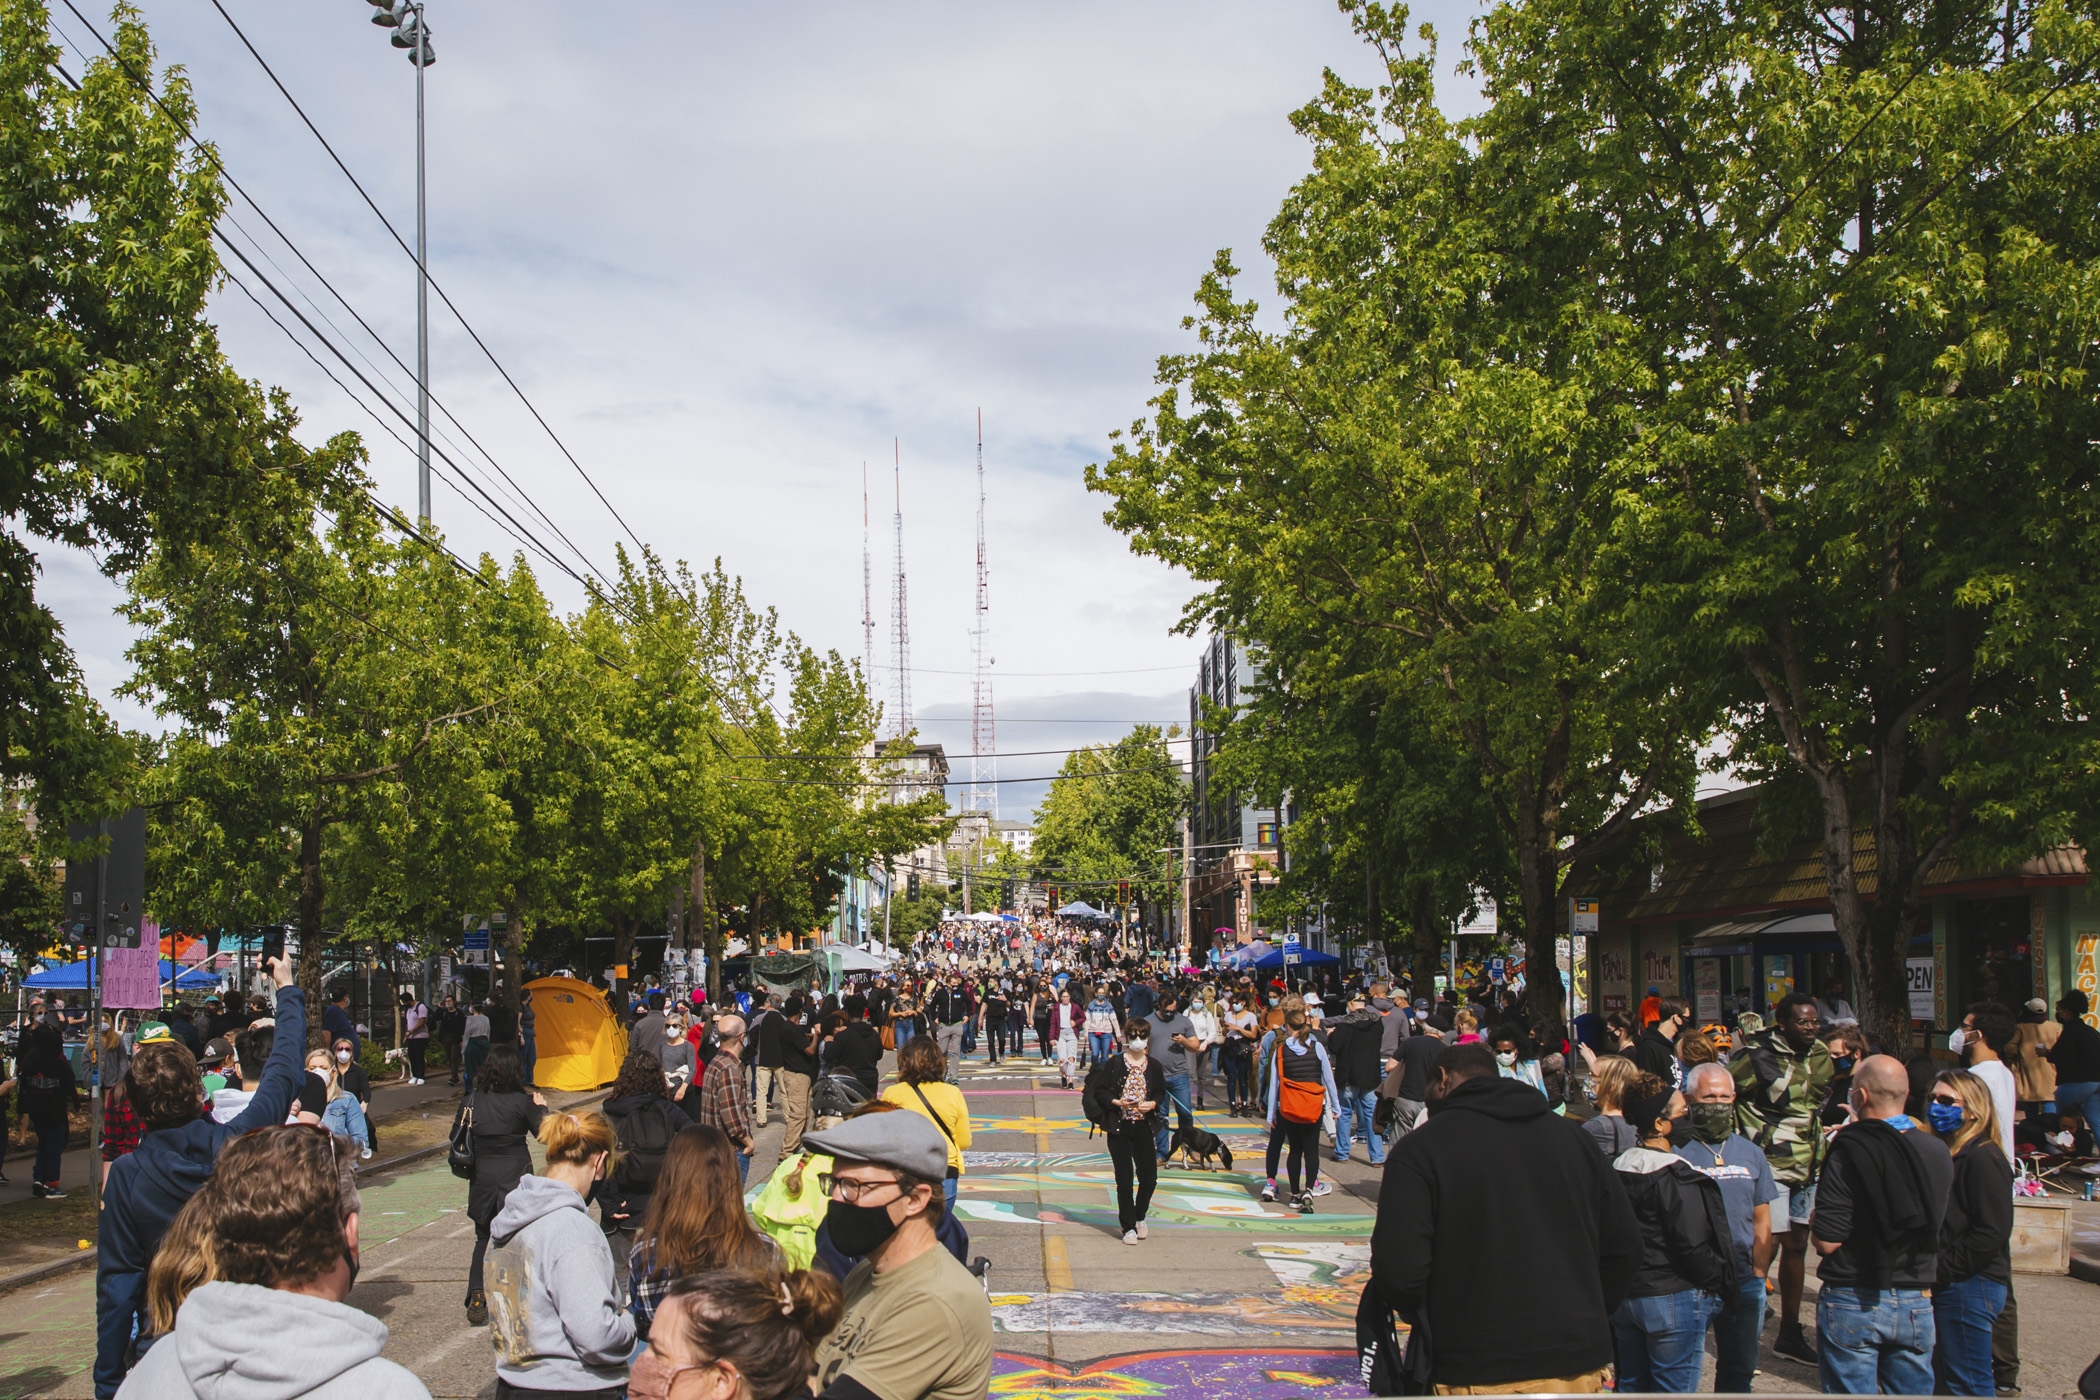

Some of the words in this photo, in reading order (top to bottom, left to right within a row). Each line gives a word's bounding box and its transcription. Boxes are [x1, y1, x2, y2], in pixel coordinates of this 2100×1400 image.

[1240, 890, 1248, 932] STOUT
[1907, 966, 1933, 990] PEN
[1935, 945, 1945, 1030] TACOS
[2076, 934, 2099, 1030] NACHO
